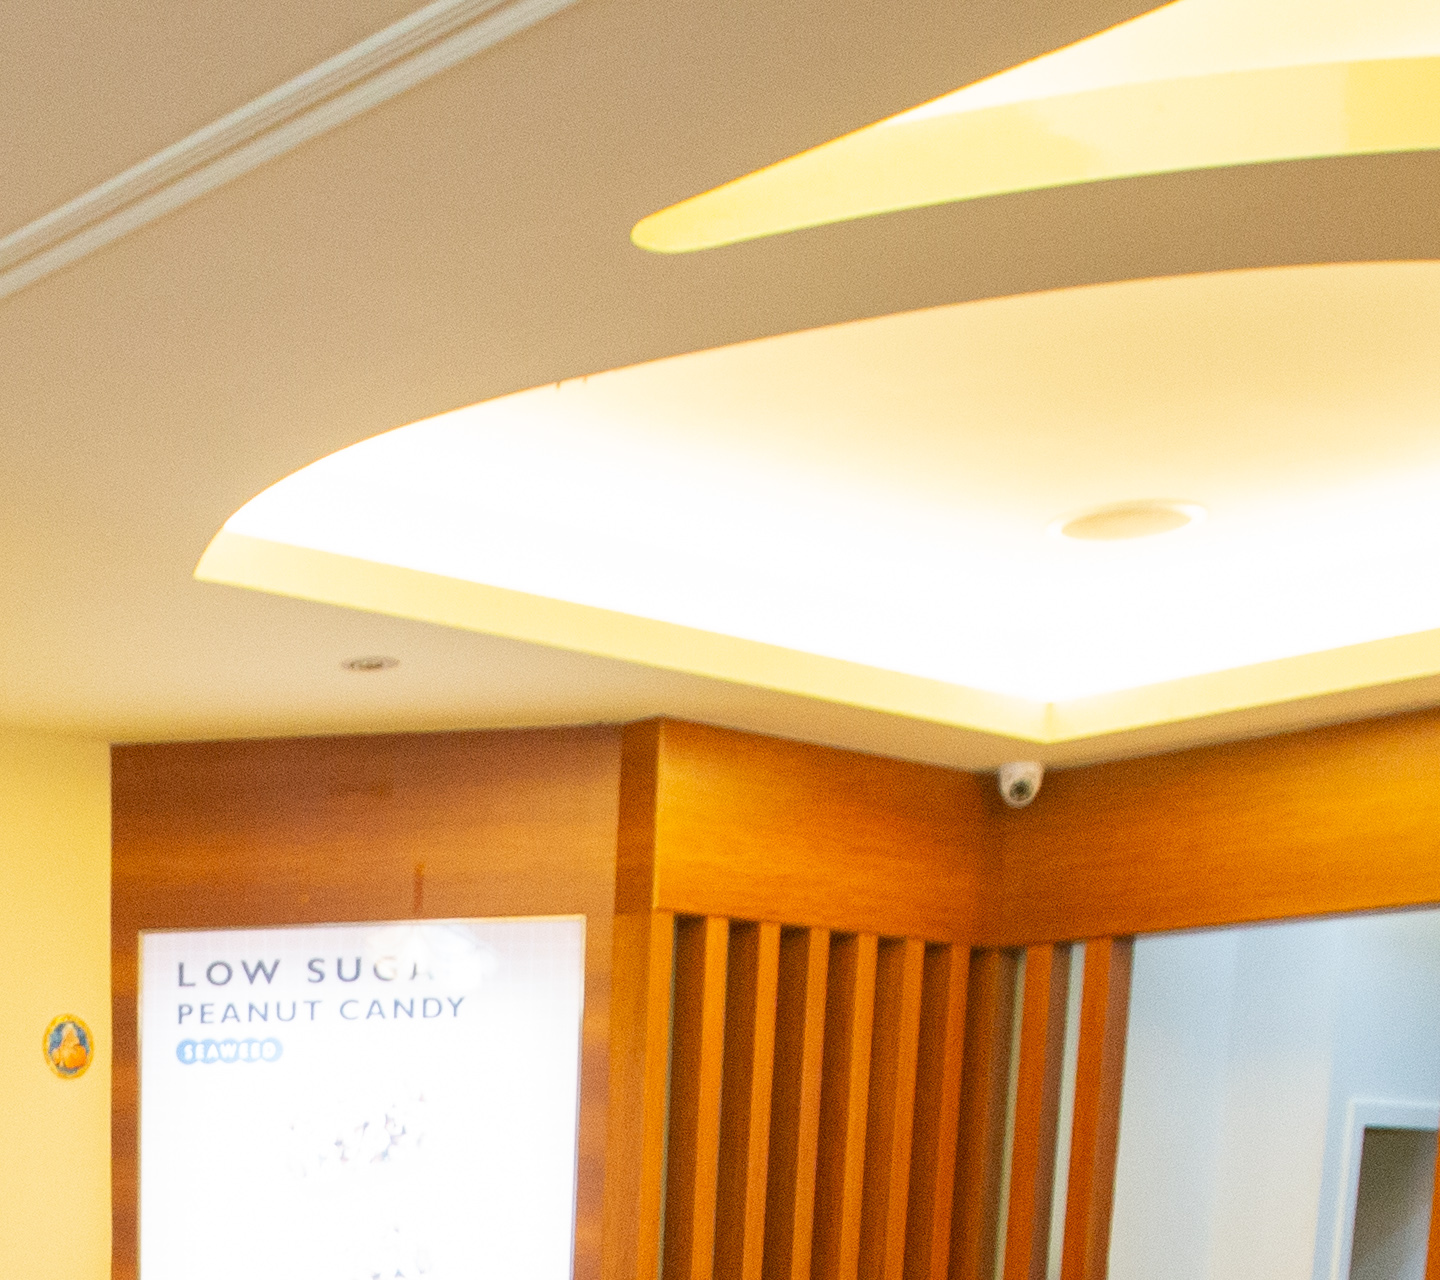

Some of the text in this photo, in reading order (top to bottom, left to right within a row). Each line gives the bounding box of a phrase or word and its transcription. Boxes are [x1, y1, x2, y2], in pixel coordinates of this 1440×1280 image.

[178, 955, 435, 987] LOW SUGA
[178, 996, 465, 1025] PEANUT CANDY
[183, 1041, 277, 1061] SEAWEED
